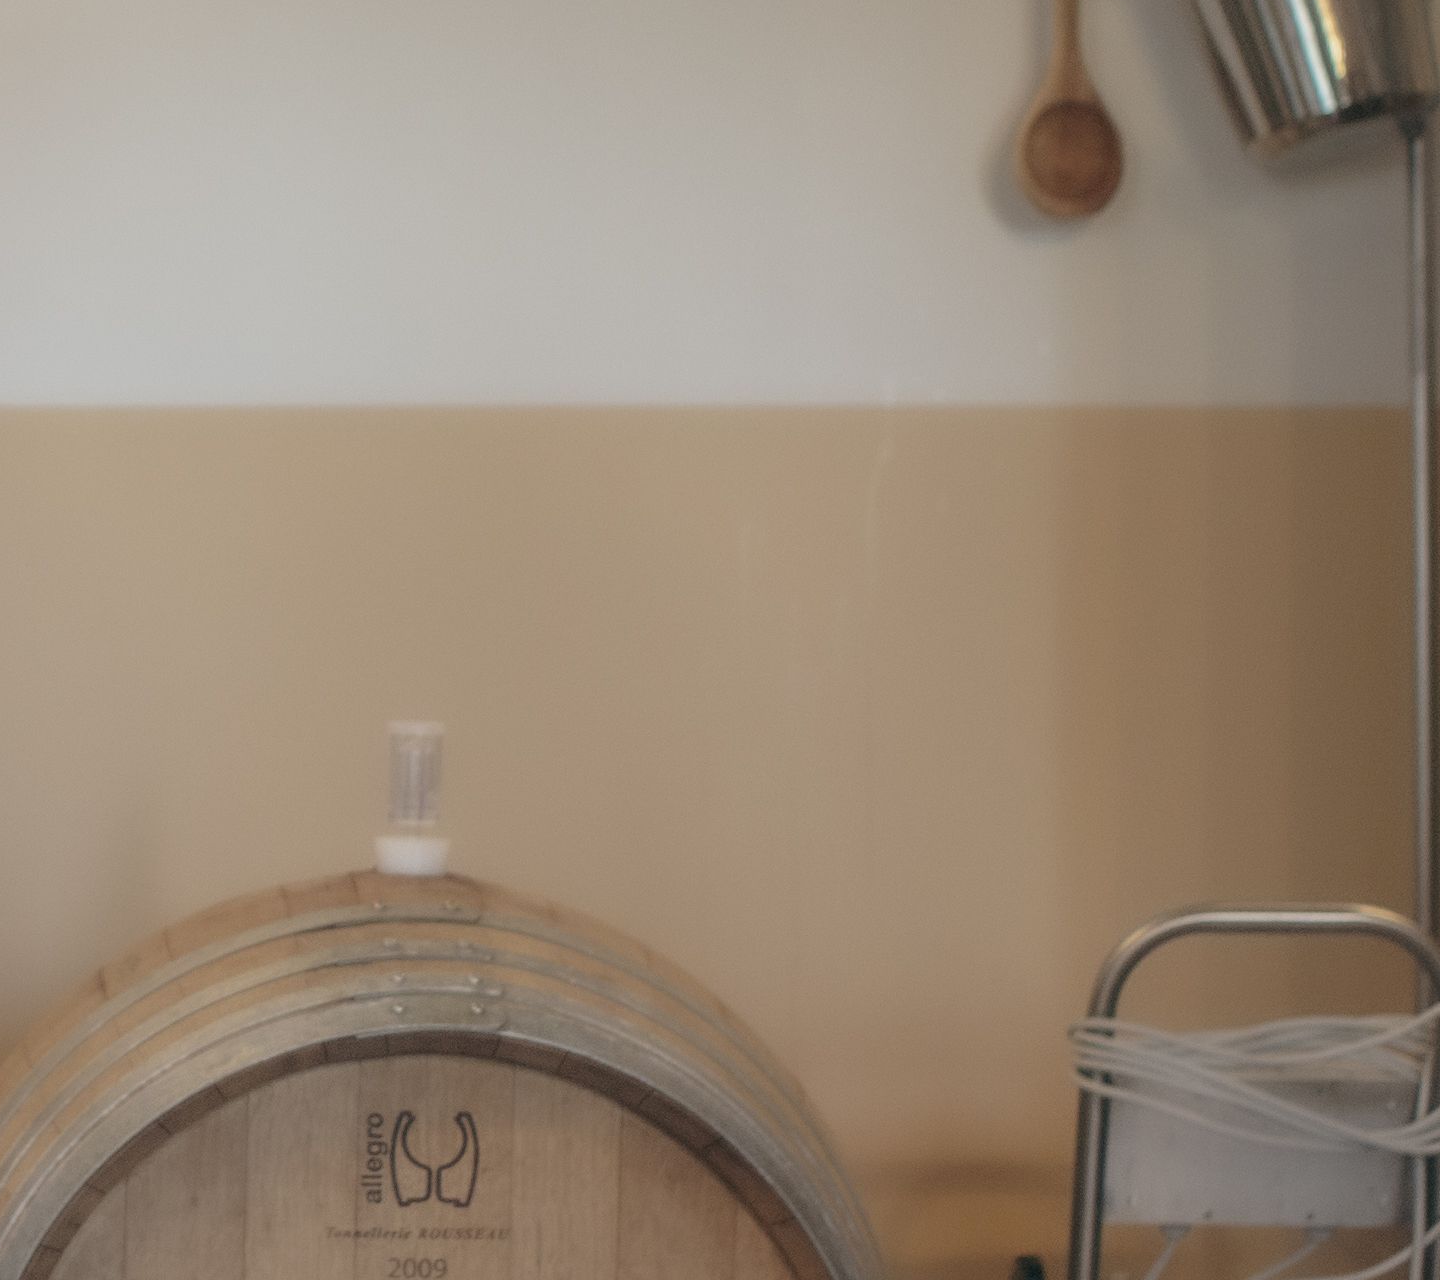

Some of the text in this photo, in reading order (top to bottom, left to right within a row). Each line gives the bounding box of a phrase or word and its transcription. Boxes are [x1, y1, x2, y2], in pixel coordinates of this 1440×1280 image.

[361, 1111, 388, 1204] allegro
[417, 1226, 512, 1241] ROUSSEAU
[386, 1256, 449, 1280] 2009
